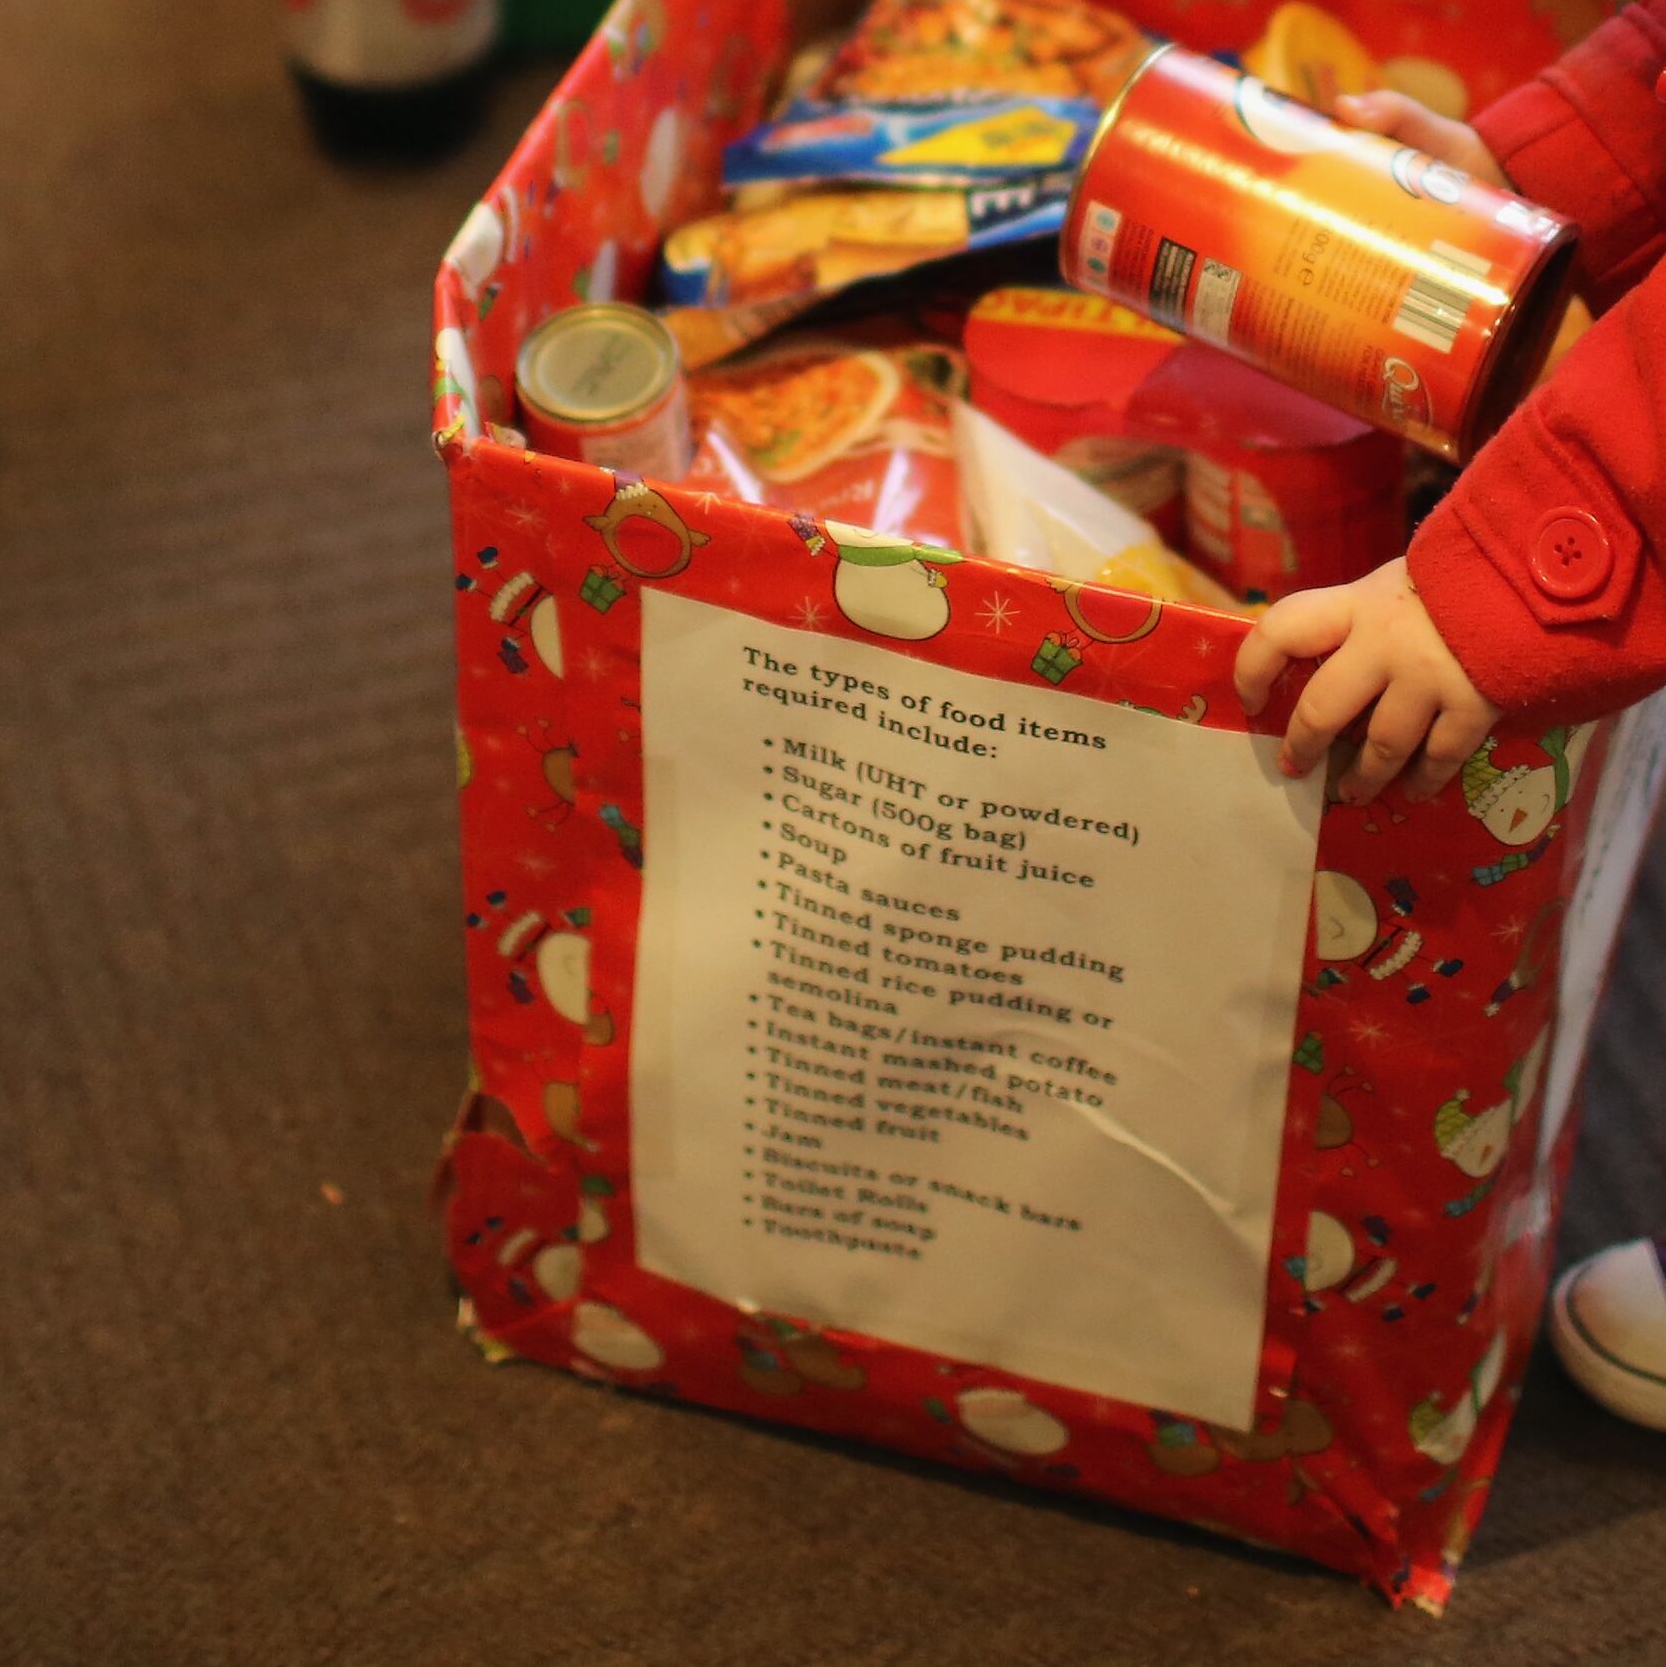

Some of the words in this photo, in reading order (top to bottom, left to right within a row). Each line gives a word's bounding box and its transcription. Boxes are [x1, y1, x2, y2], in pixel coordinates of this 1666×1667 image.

[743, 646, 799, 676] The
[810, 665, 890, 700] types
[901, 695, 932, 713] of
[940, 701, 1006, 732] food
[1018, 717, 1107, 750] items
[743, 678, 867, 722] required
[879, 710, 998, 759] include:
[782, 765, 862, 808] Sugar
[872, 798, 954, 842] (500g
[964, 821, 1027, 852] bag)
[783, 738, 846, 771] Milk
[857, 762, 927, 800] (UHT
[938, 792, 969, 810] or
[980, 799, 1140, 846] powdered)
[779, 822, 848, 865] Soup
[782, 793, 890, 849] Cartons
[900, 839, 932, 861] of
[940, 842, 1008, 874] fruit
[1016, 856, 1096, 889] juice
[777, 851, 850, 896] Pasta
[860, 888, 961, 922] sauces
[772, 911, 871, 958] Tinned
[882, 947, 1024, 987] tomatoes
[775, 880, 872, 932] Tinned
[882, 923, 989, 956] sponge
[1000, 943, 1125, 983] pudding
[766, 969, 899, 1017] semolina
[770, 939, 869, 986] Tinned
[880, 971, 937, 998] rice
[949, 989, 1072, 1024] pudding
[1082, 1011, 1114, 1030] or
[767, 994, 816, 1023] Tea
[828, 1010, 1018, 1059] bags/instant
[1030, 1051, 1118, 1086] coffee
[767, 1019, 869, 1061] Instant
[882, 1053, 997, 1080] mashed
[1007, 1074, 1104, 1108] potato
[765, 1071, 865, 1109] Tinned
[875, 1099, 1030, 1142] vegetables
[766, 1045, 865, 1085] Tinned
[876, 1076, 1023, 1114] meat/fish
[762, 1122, 822, 1150] Jam
[765, 1097, 864, 1132] Tinned
[876, 1119, 940, 1143] fruit
[763, 1146, 879, 1181] Biscuits
[888, 1171, 919, 1187] or
[763, 1171, 845, 1202] Toilet
